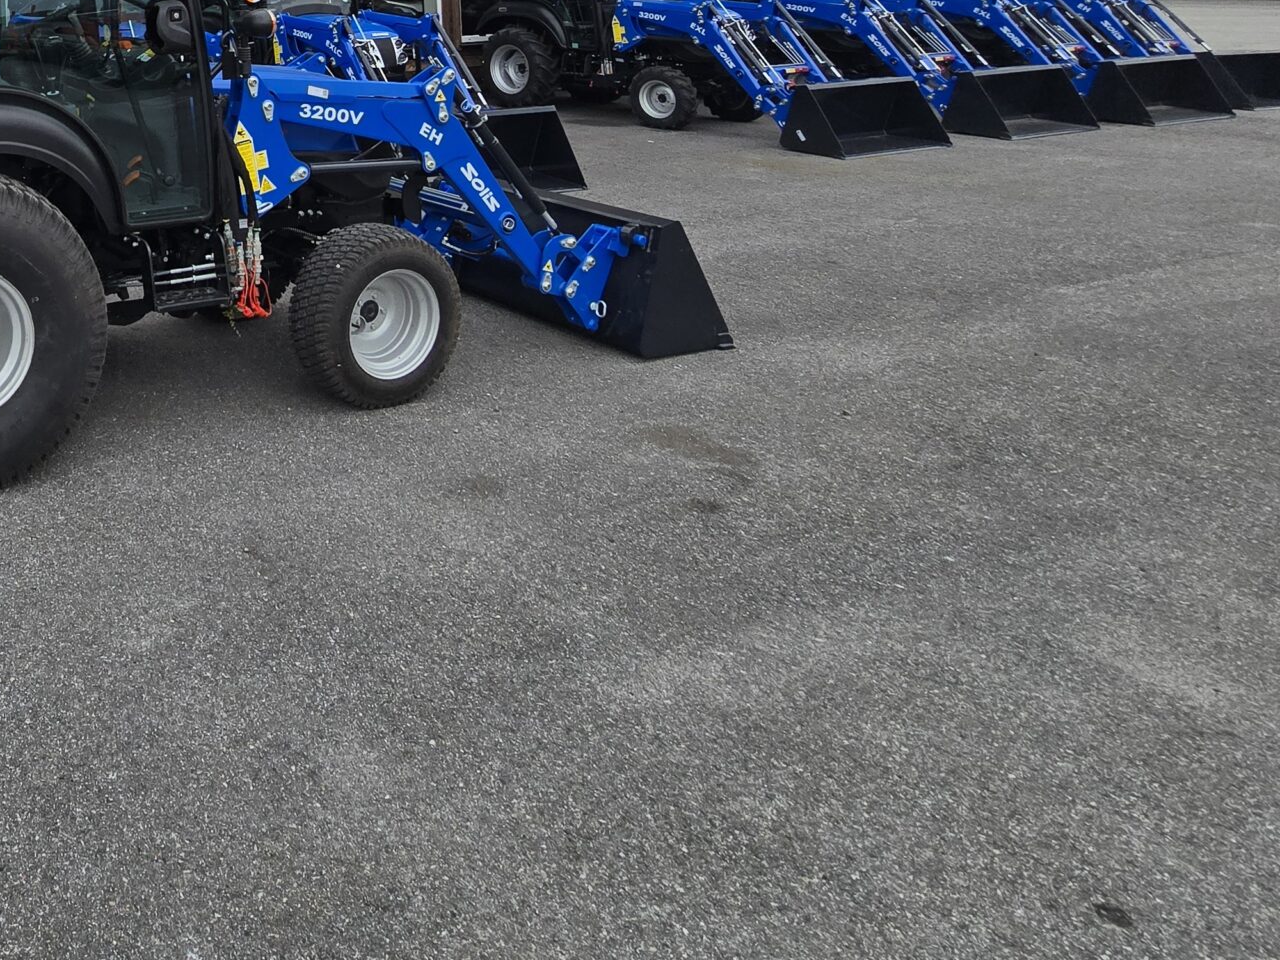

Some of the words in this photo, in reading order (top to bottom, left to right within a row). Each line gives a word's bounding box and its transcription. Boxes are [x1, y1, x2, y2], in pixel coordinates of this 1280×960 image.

[785, 3, 816, 13] 3200V
[638, 11, 667, 21] 3200V
[840, 13, 857, 27] EXL
[292, 28, 313, 40] 3200V
[689, 22, 706, 36] EXL
[299, 103, 365, 125] 3200V
[419, 122, 443, 145] EH
